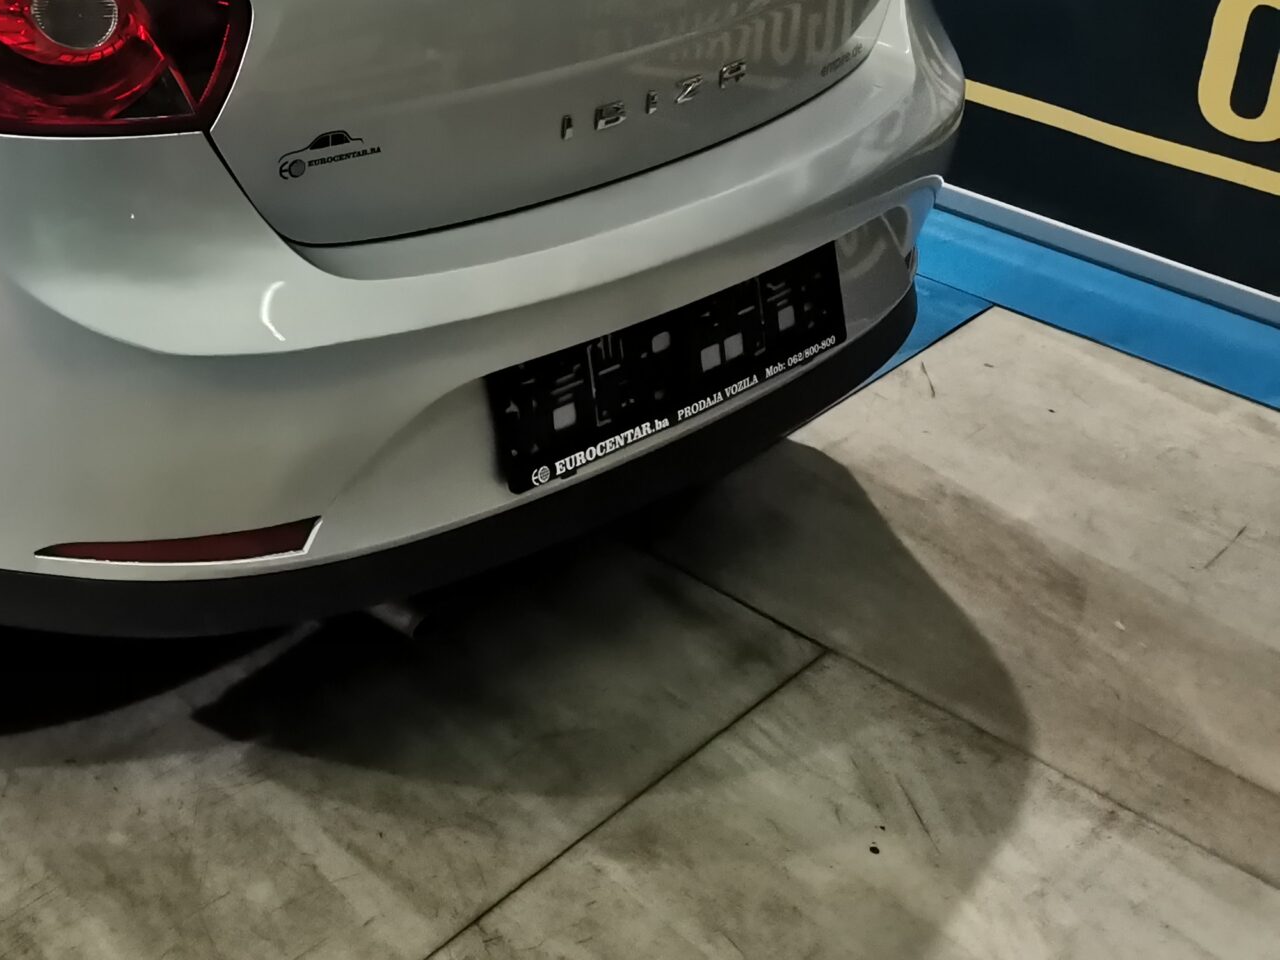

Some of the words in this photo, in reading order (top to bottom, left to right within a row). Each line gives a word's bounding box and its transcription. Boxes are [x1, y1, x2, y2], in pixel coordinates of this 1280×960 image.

[560, 58, 747, 141] IBIZA
[308, 146, 381, 166] EUROCENTAR.BA
[554, 417, 670, 476] EUROCENTAR.ba
[677, 391, 724, 421] PRODAJA
[724, 374, 759, 398] VOZILA
[765, 362, 786, 379] Mob:
[787, 335, 836, 367] 062/800-800
